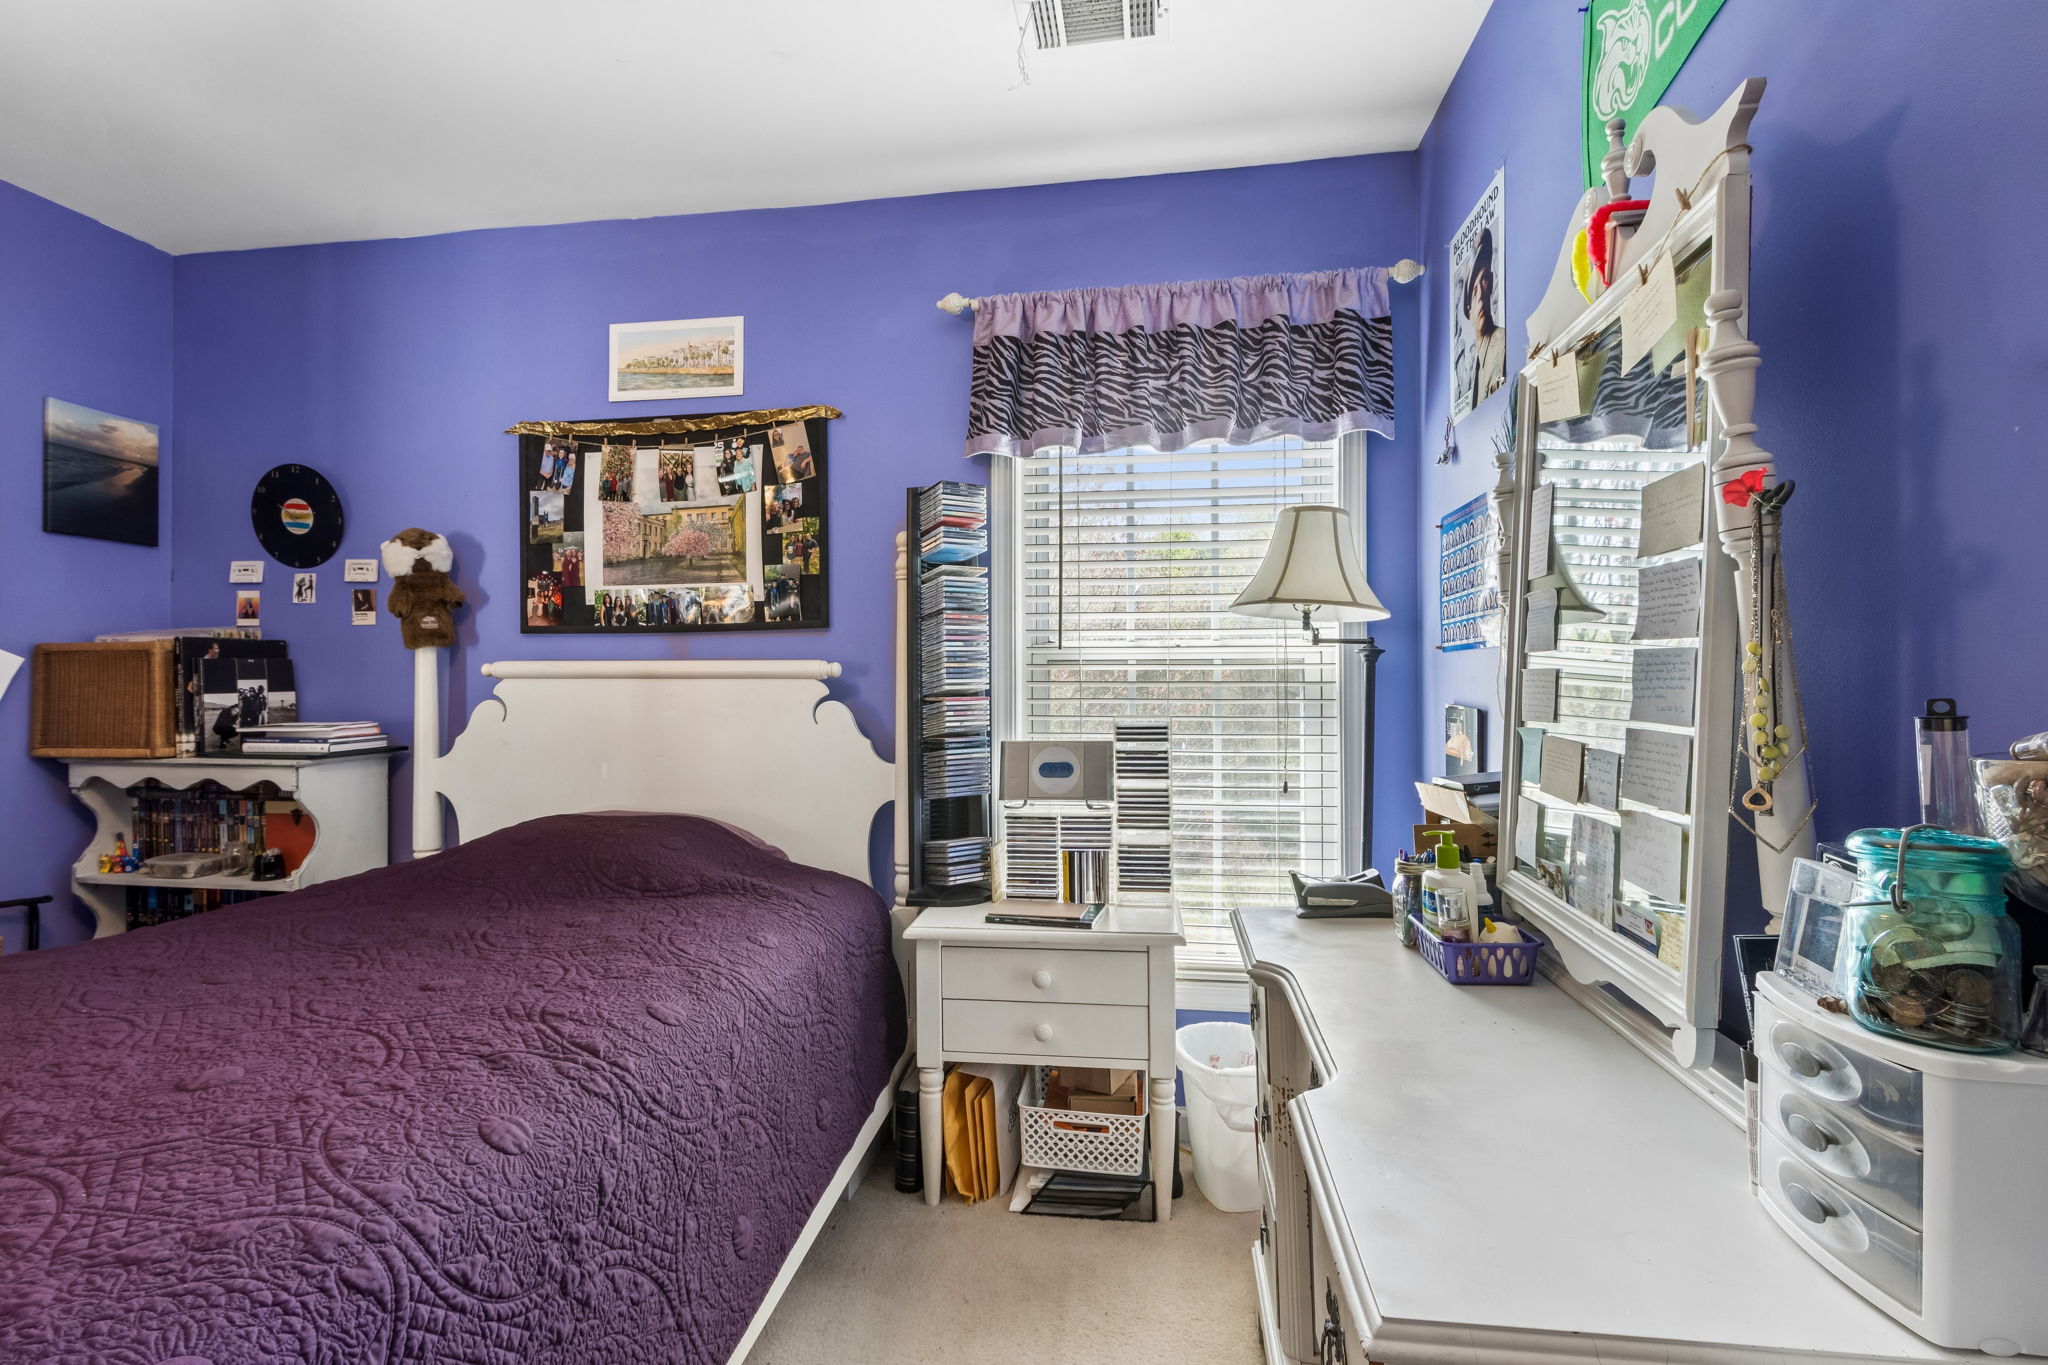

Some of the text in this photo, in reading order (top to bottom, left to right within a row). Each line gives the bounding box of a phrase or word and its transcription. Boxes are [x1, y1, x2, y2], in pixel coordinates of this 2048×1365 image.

[1453, 186, 1499, 256] BLOODHOUND
[1455, 246, 1465, 266] OF
[271, 470, 279, 479] 11
[291, 465, 300, 473] 12
